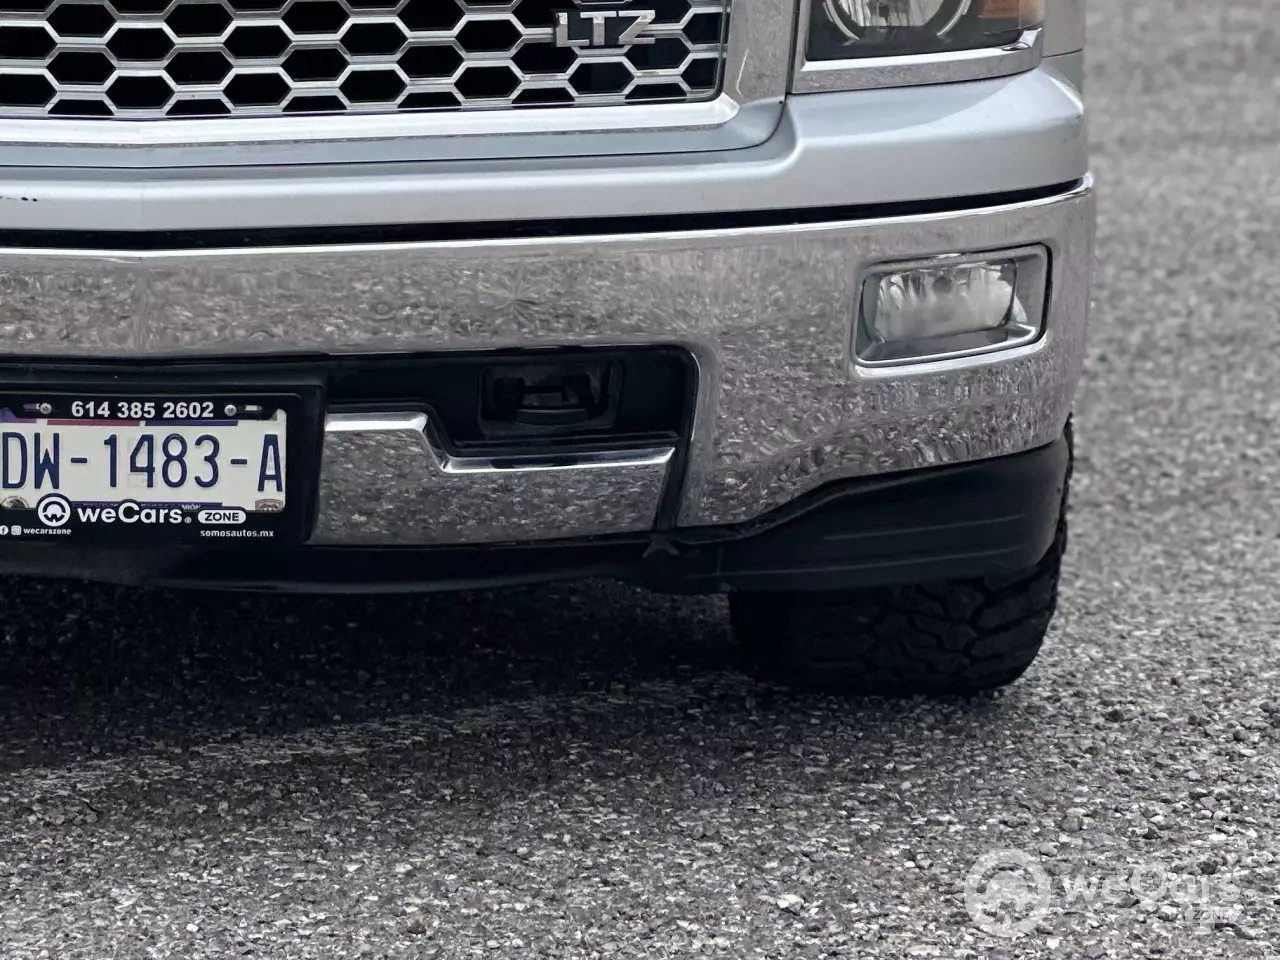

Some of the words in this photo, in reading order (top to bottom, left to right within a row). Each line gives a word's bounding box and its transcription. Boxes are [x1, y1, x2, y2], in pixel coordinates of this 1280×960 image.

[555, 9, 656, 47] LTZ
[71, 401, 110, 417] 614
[117, 401, 156, 418] 385
[162, 401, 214, 418] 2602
[1, 431, 284, 492] DW-1483-A
[204, 512, 239, 521] ZONE
[23, 527, 72, 535] wecarszone
[200, 529, 274, 537] somosautos.mx
